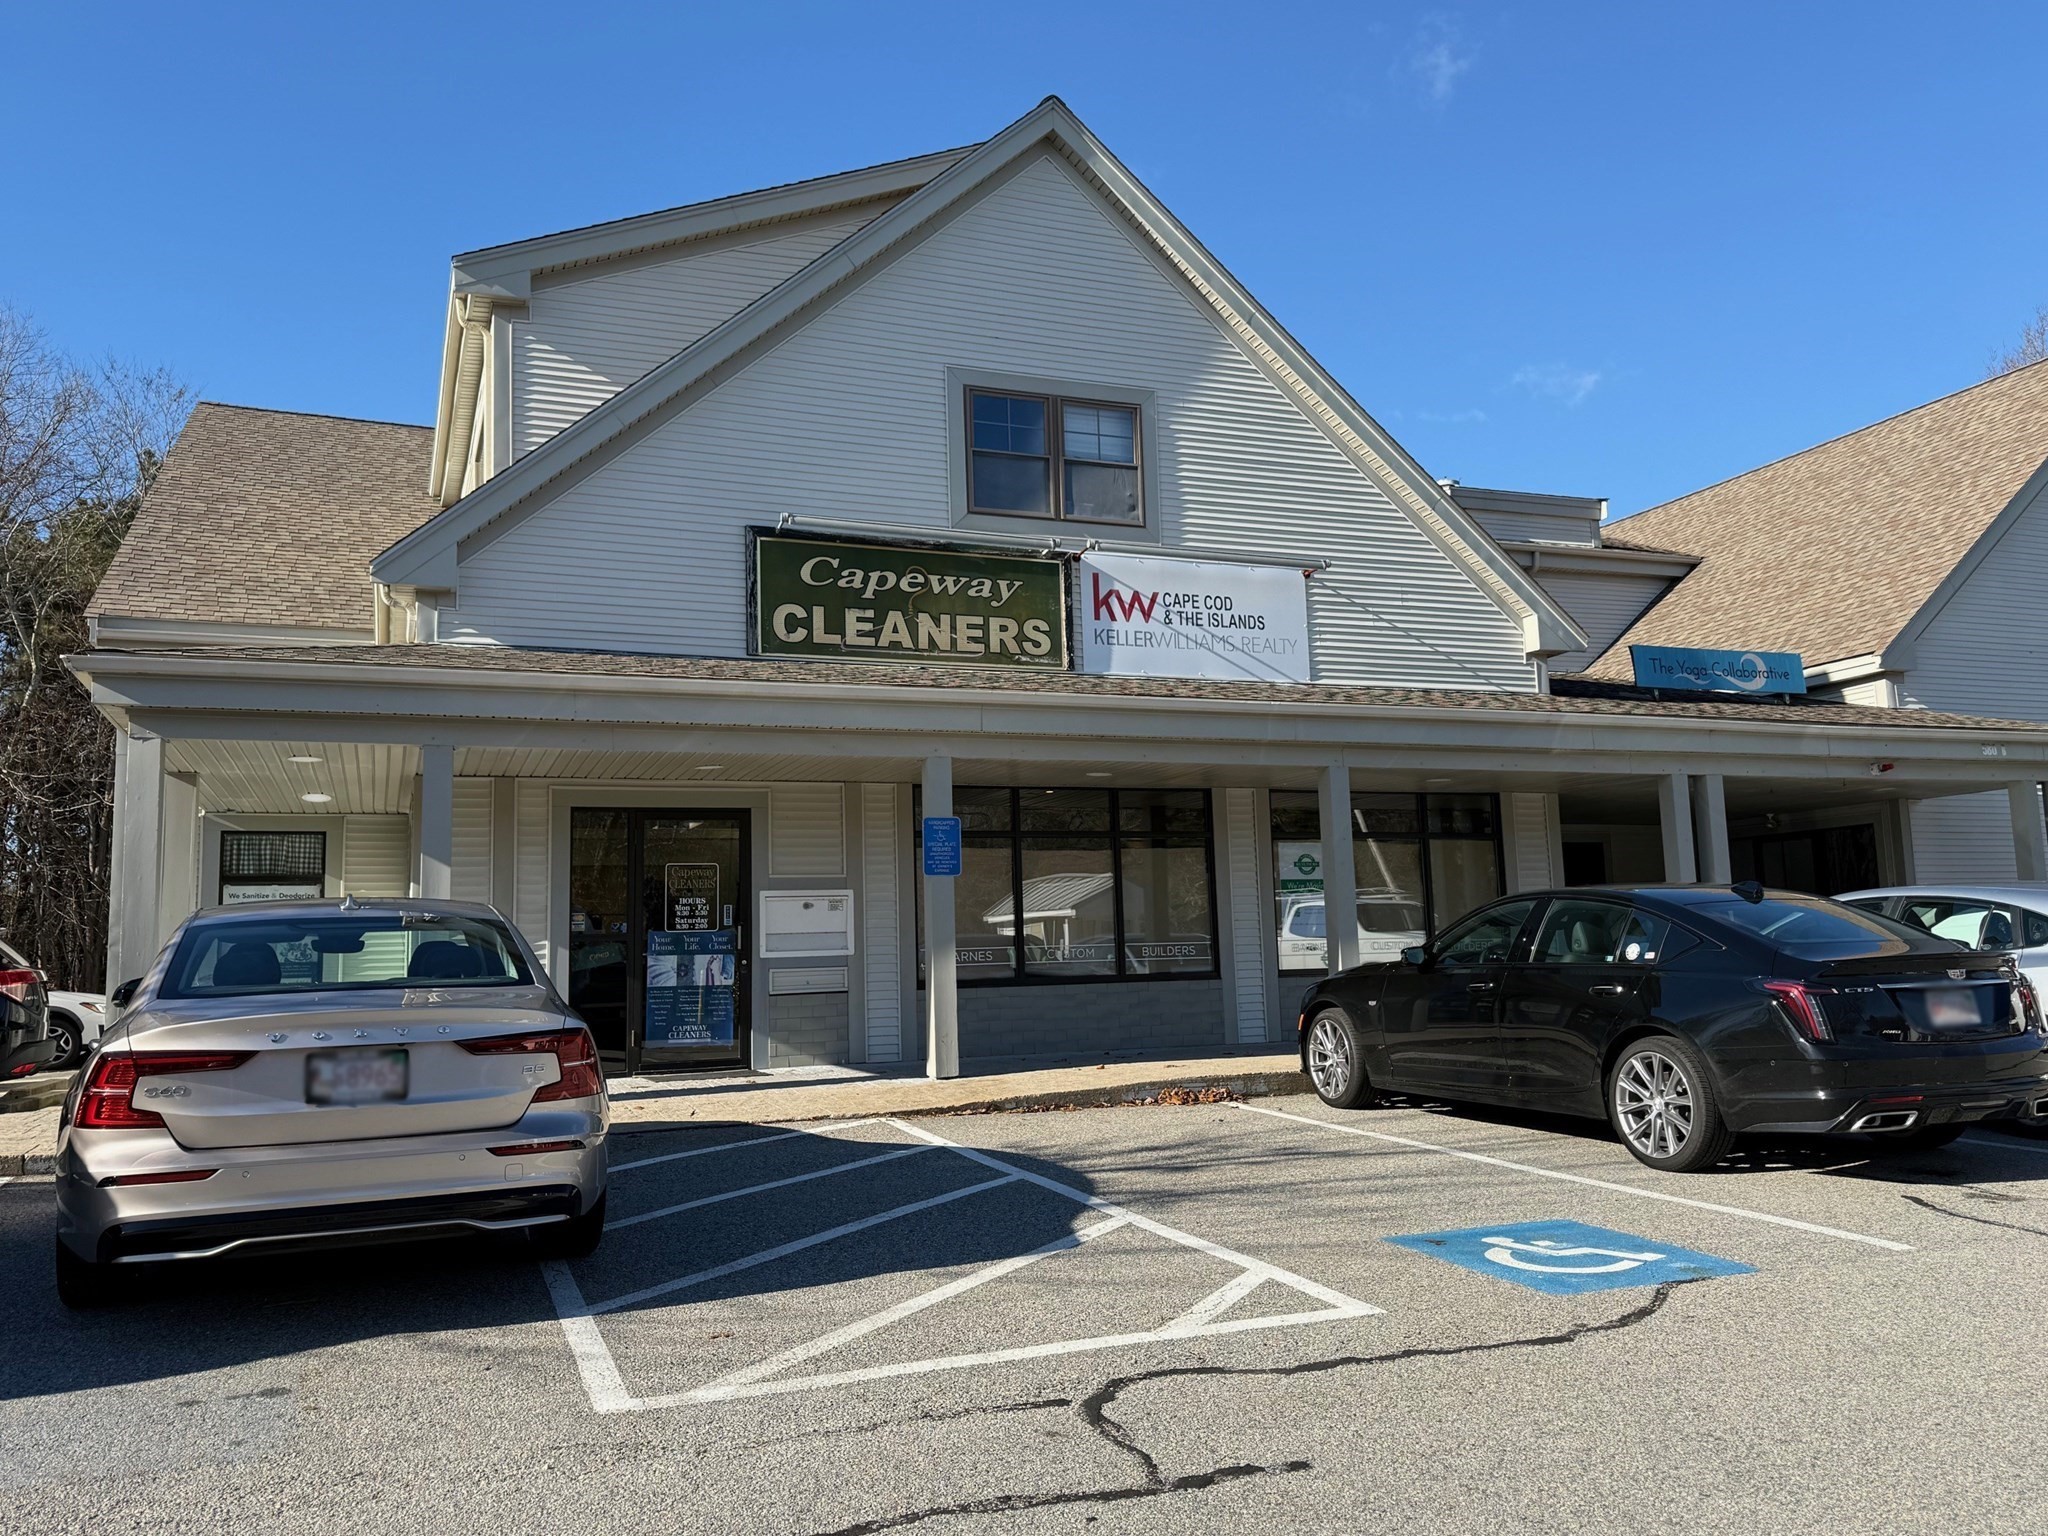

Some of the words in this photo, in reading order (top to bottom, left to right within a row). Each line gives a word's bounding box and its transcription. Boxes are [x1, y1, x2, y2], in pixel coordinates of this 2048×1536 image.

[799, 555, 1024, 608] Capeway
[1092, 572, 1160, 624] kw
[1162, 592, 1200, 610] CAPE
[1203, 594, 1233, 612] COD
[1163, 610, 1173, 625] &
[1177, 610, 1204, 627] THE
[1207, 613, 1266, 631] ISLANDS
[771, 602, 1053, 656] CLEANERS
[1242, 636, 1298, 655] REALTY
[1648, 657, 1674, 675] The
[1676, 659, 1708, 681] Yoga
[1711, 661, 1790, 681] Collaborative
[671, 866, 716, 879] Capeway
[668, 879, 716, 889] CLEANERS
[679, 897, 706, 905] HOURS
[674, 917, 709, 925] Saturday
[654, 935, 672, 943] Your
[683, 934, 701, 943] Your
[711, 934, 729, 942] Your
[652, 943, 676, 951] Home.
[684, 942, 701, 951] Life.
[708, 942, 733, 950] Closet.
[1291, 942, 1328, 953] BARNE
[1369, 940, 1415, 951] CUSTOM
[954, 950, 993, 962] ARNES
[1141, 945, 1197, 957] BUILDERS
[265, 1024, 450, 1043] VOLVO
[672, 1024, 708, 1032] CAPEWAY
[668, 1031, 712, 1039] CLEANERS
[521, 1062, 547, 1075] B5
[143, 1085, 188, 1097] S60
